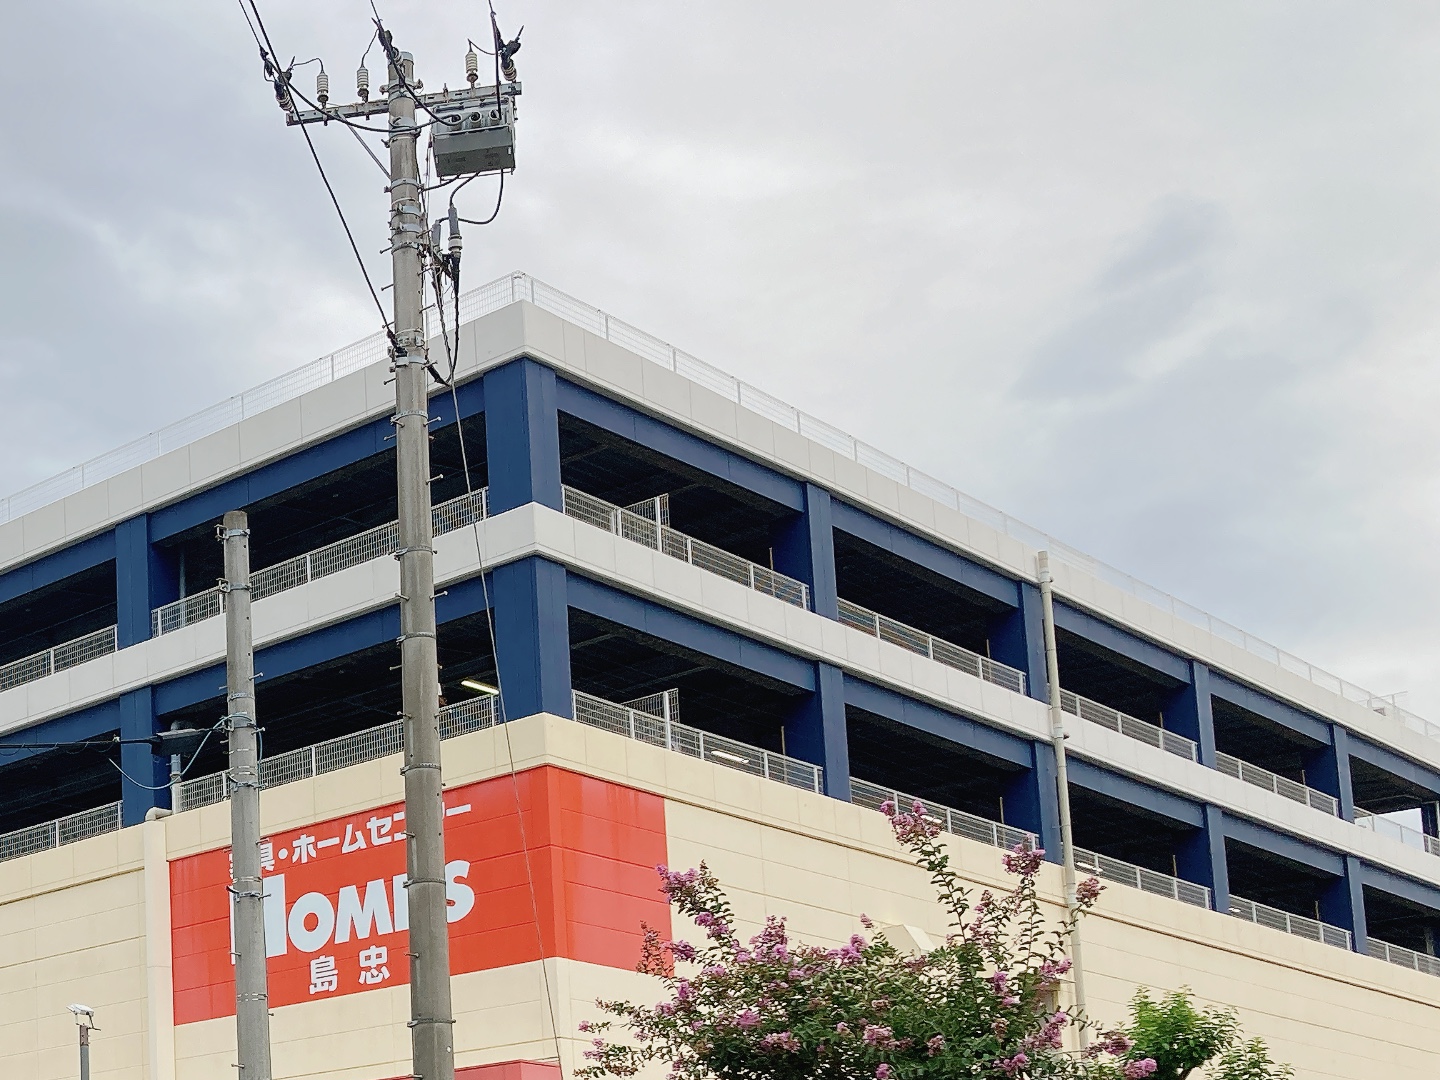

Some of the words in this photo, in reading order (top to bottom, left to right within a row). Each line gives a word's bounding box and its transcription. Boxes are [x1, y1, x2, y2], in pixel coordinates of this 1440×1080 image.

[228, 803, 472, 878] 具・ホームセー
[309, 944, 390, 995] 島忠
